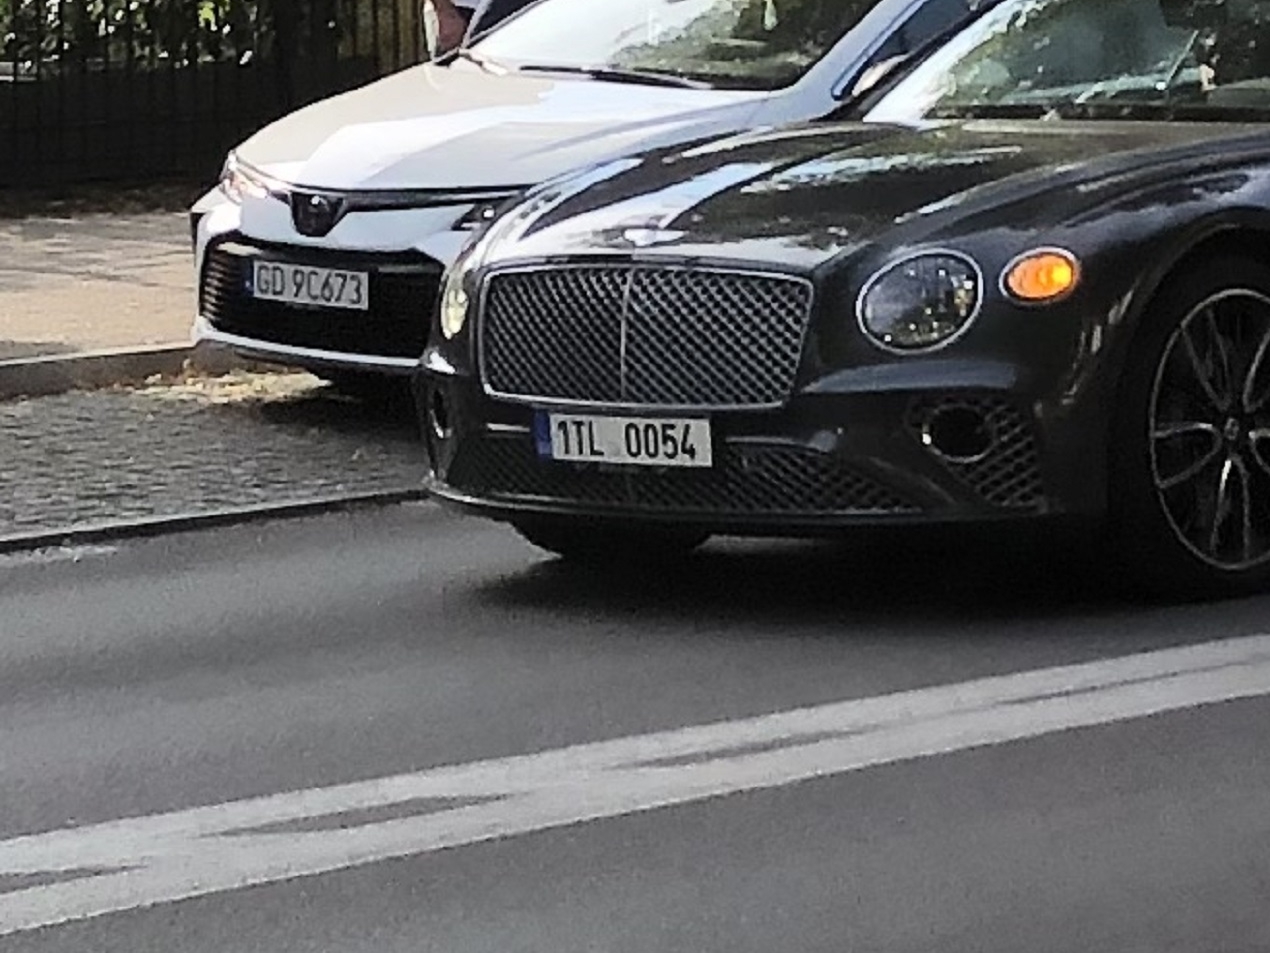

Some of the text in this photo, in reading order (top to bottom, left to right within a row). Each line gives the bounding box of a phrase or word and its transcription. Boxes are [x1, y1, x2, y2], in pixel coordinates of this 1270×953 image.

[256, 265, 363, 305] GD 9C673
[557, 420, 696, 459] 1TL 0054
